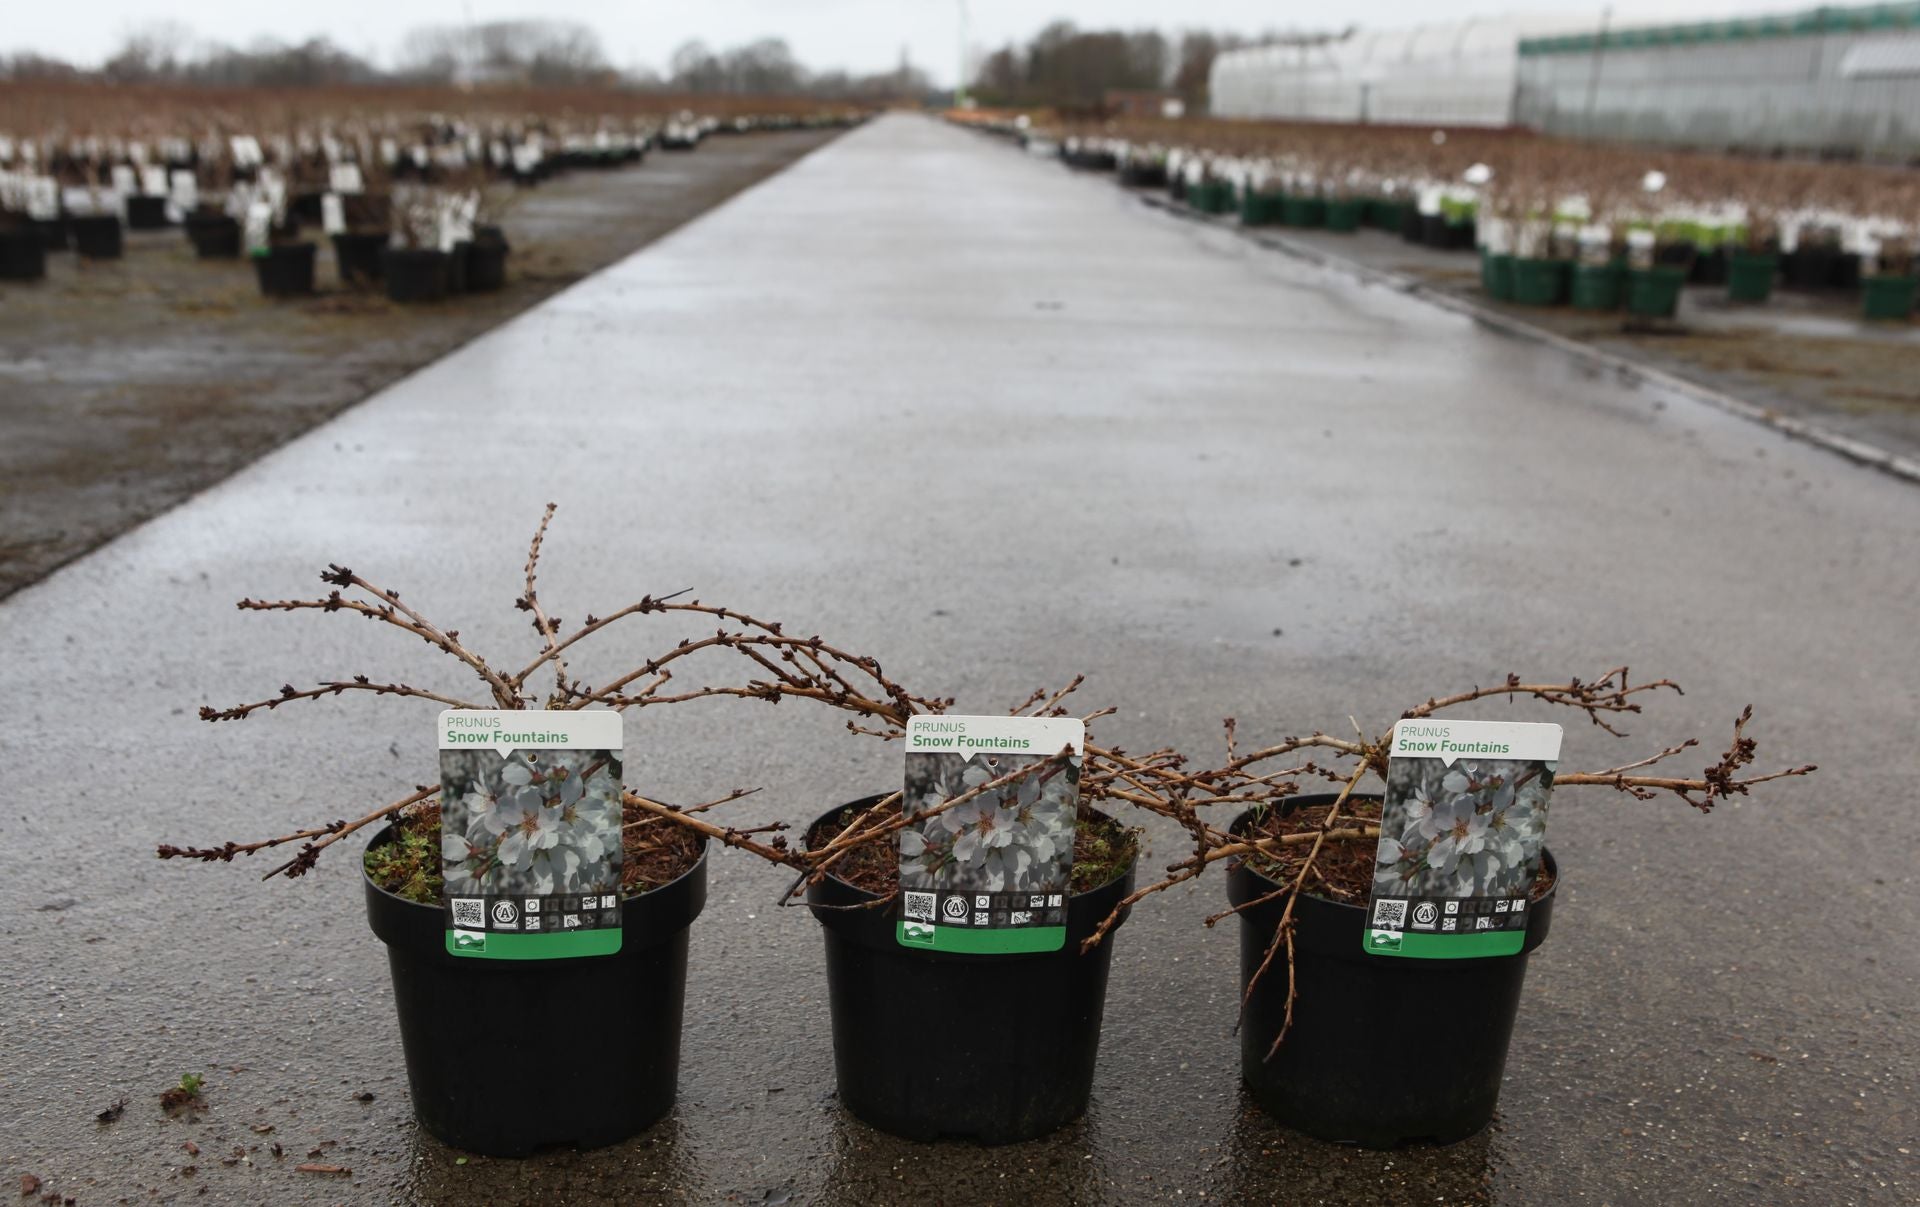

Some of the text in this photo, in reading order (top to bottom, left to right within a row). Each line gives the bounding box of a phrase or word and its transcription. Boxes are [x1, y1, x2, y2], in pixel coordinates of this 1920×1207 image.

[447, 717, 501, 728] PRUNUS
[914, 722, 966, 733] PRUNUS
[447, 731, 569, 743] Snow Fountains
[1401, 726, 1450, 737] PRUNUS
[913, 735, 1030, 749] Snow Fountains
[1398, 739, 1510, 753] Snow Fountains
